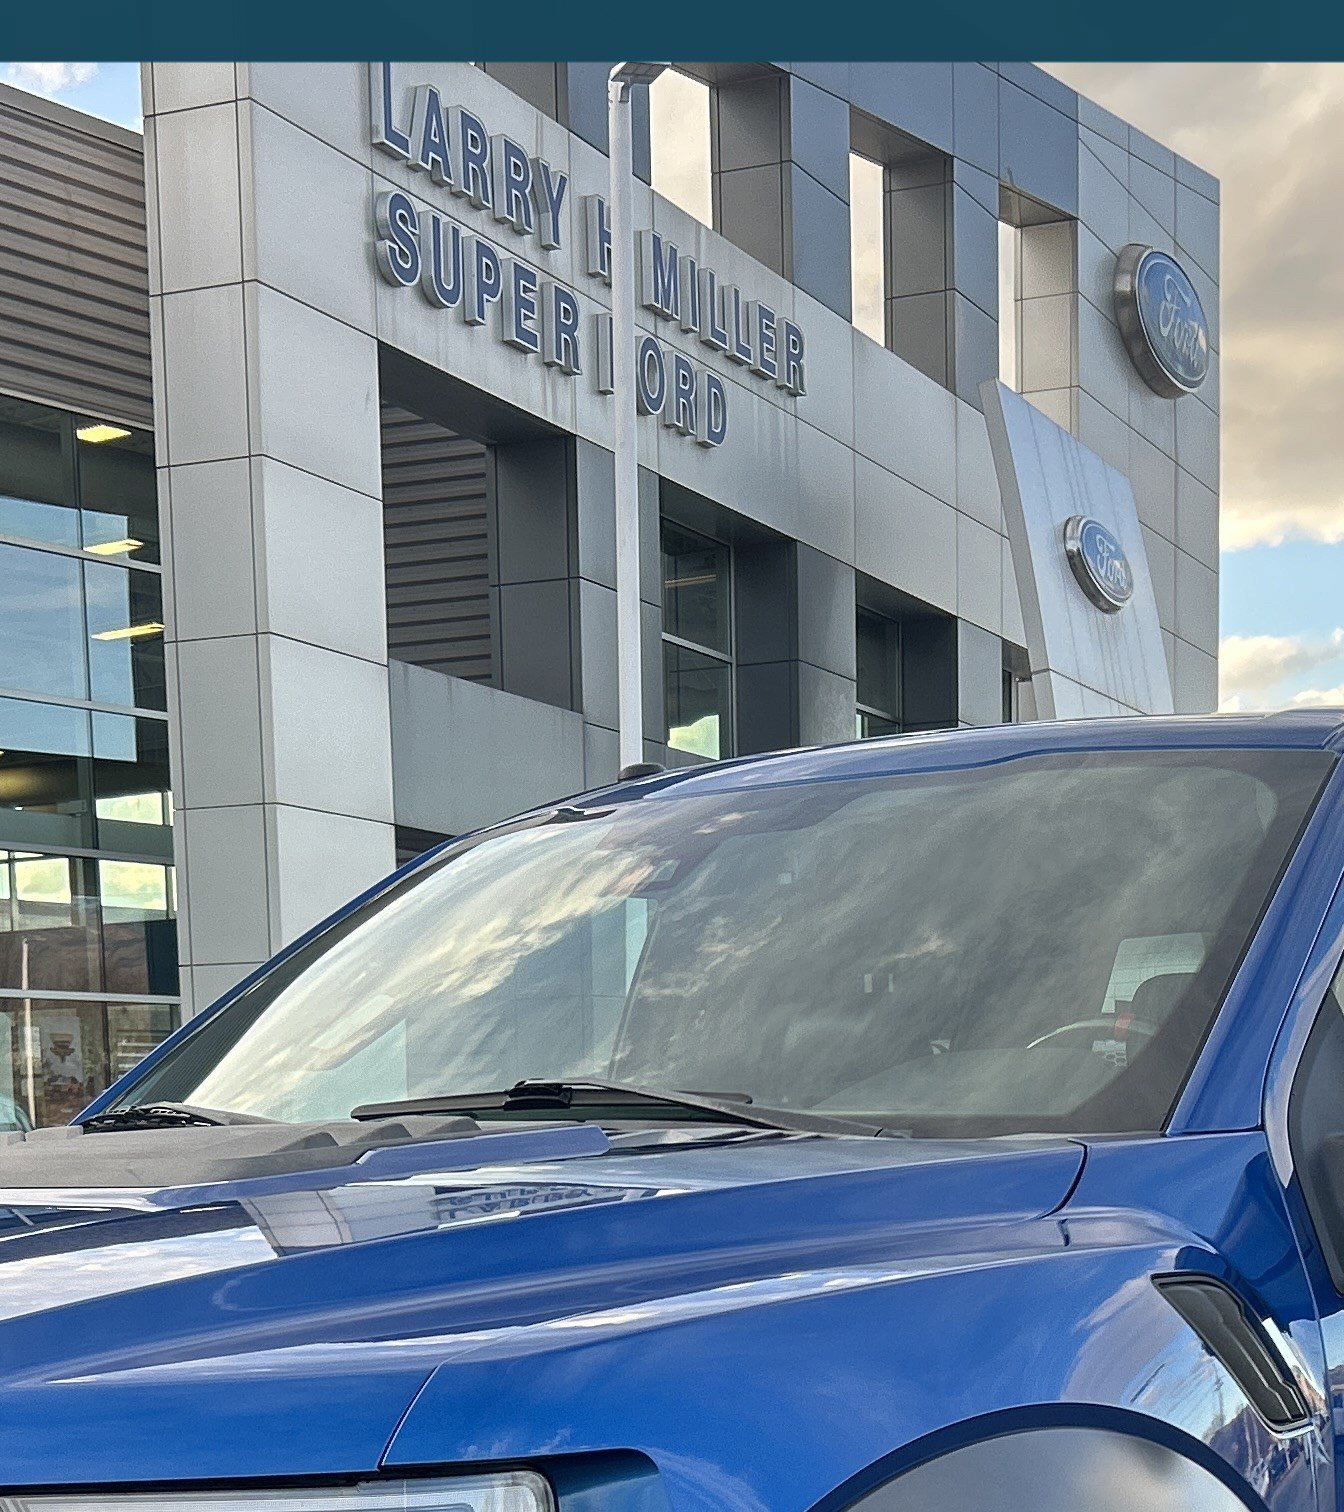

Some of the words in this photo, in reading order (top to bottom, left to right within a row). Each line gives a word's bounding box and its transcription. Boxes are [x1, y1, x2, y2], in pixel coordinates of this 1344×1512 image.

[373, 62, 568, 250] LARRY
[640, 228, 807, 397] MILLER
[375, 190, 582, 375] SUPER
[594, 312, 727, 448] ORD
[1158, 273, 1201, 368] Ford
[1096, 532, 1128, 591] Ford
